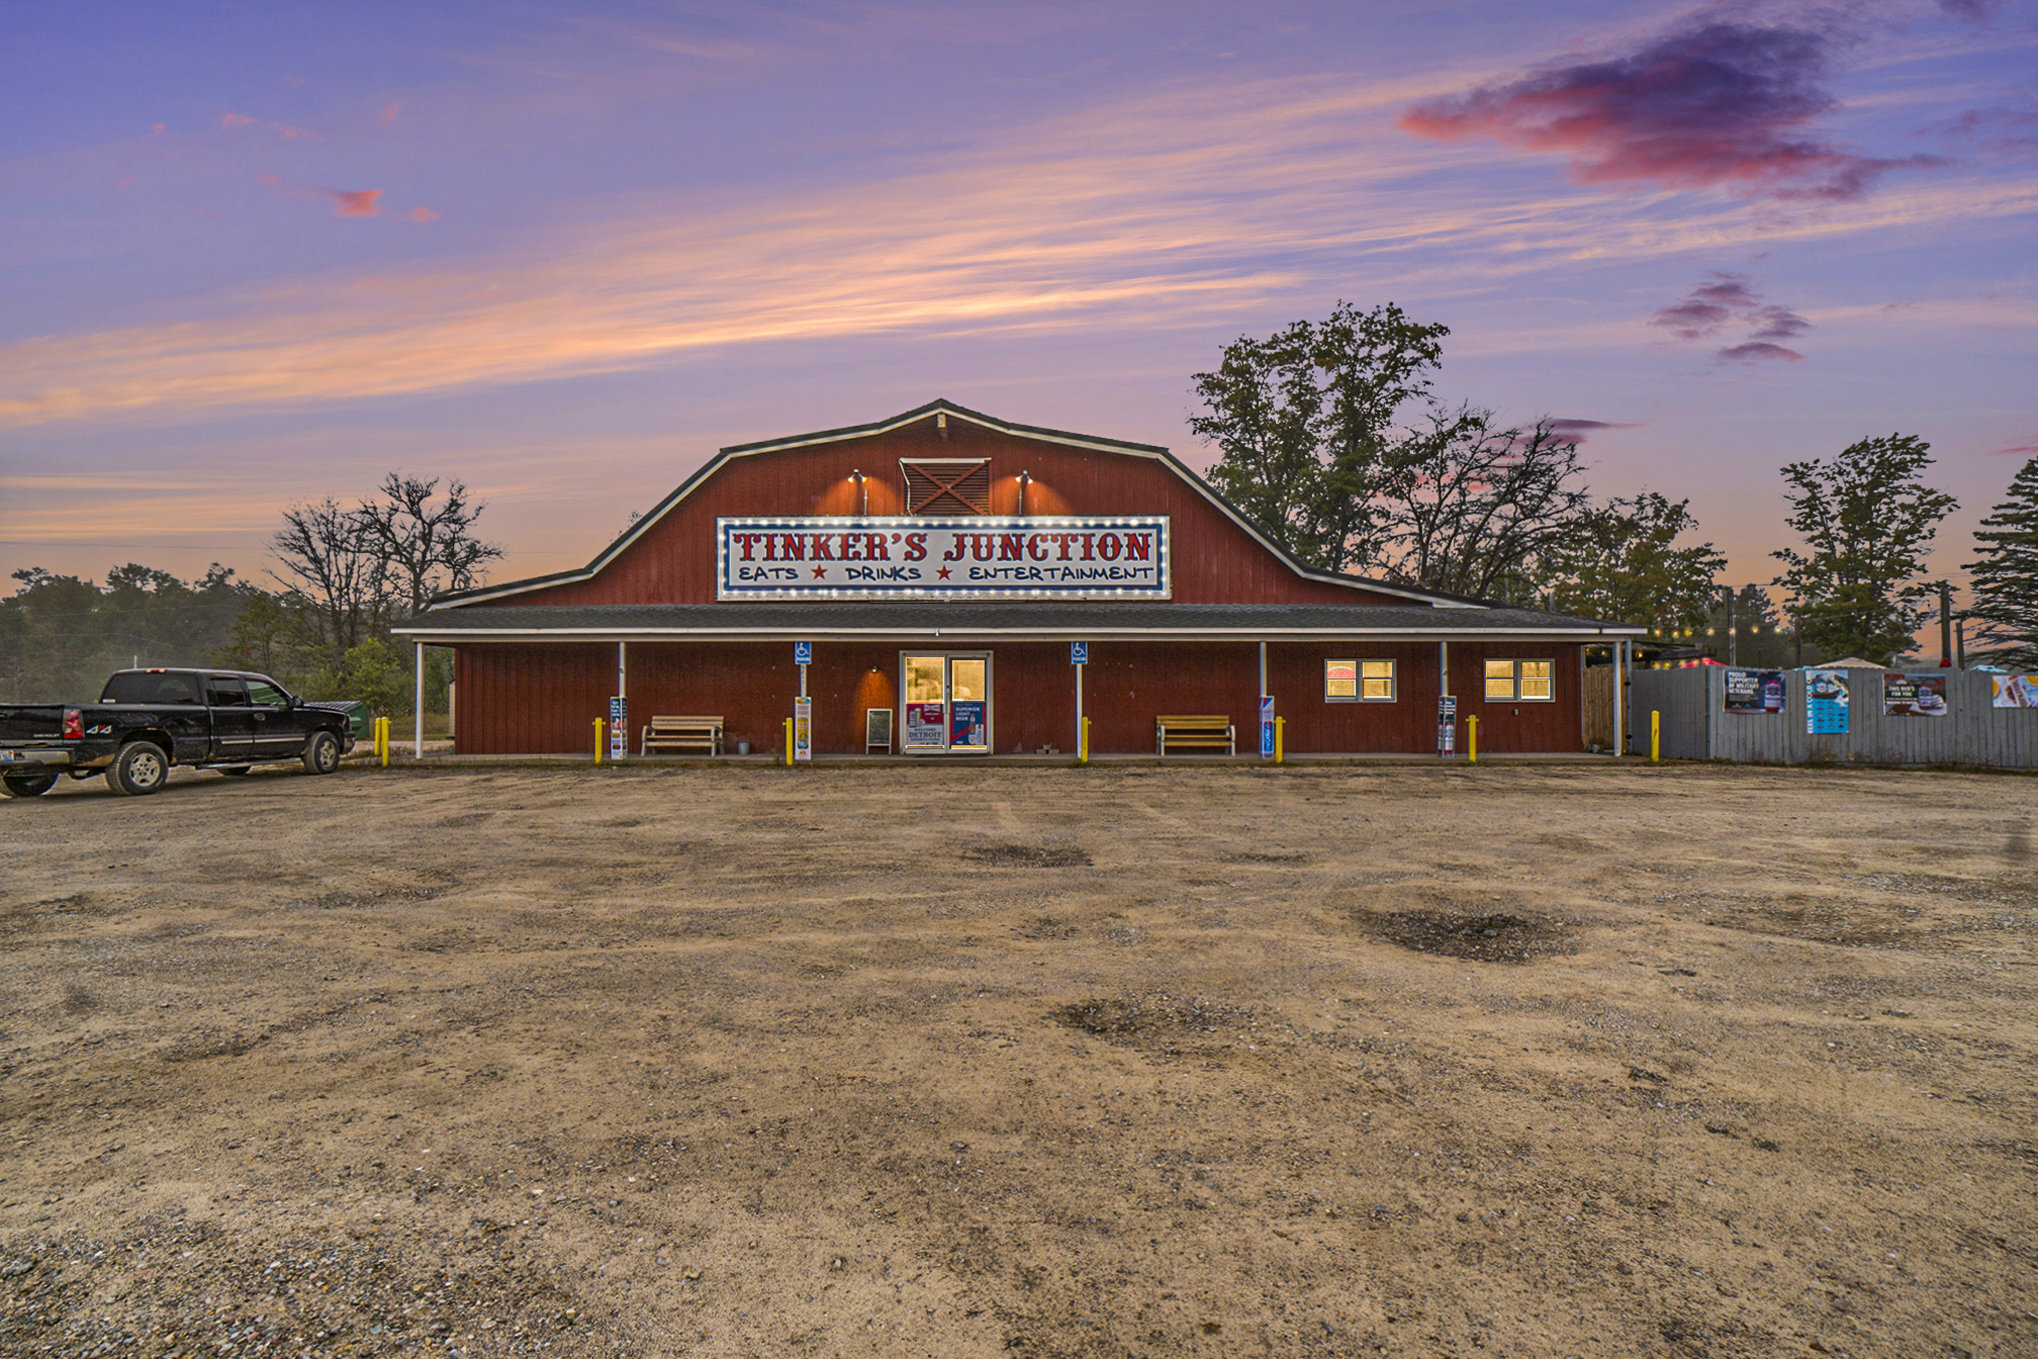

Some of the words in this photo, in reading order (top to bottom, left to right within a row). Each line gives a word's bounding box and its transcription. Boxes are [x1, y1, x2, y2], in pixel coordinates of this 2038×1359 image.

[733, 532, 928, 562] TINKER'S
[943, 532, 1153, 562] JUNCTION
[738, 566, 799, 581] EATS
[845, 566, 922, 582] DRINKS
[968, 566, 1154, 581] ENTERTAINMENT
